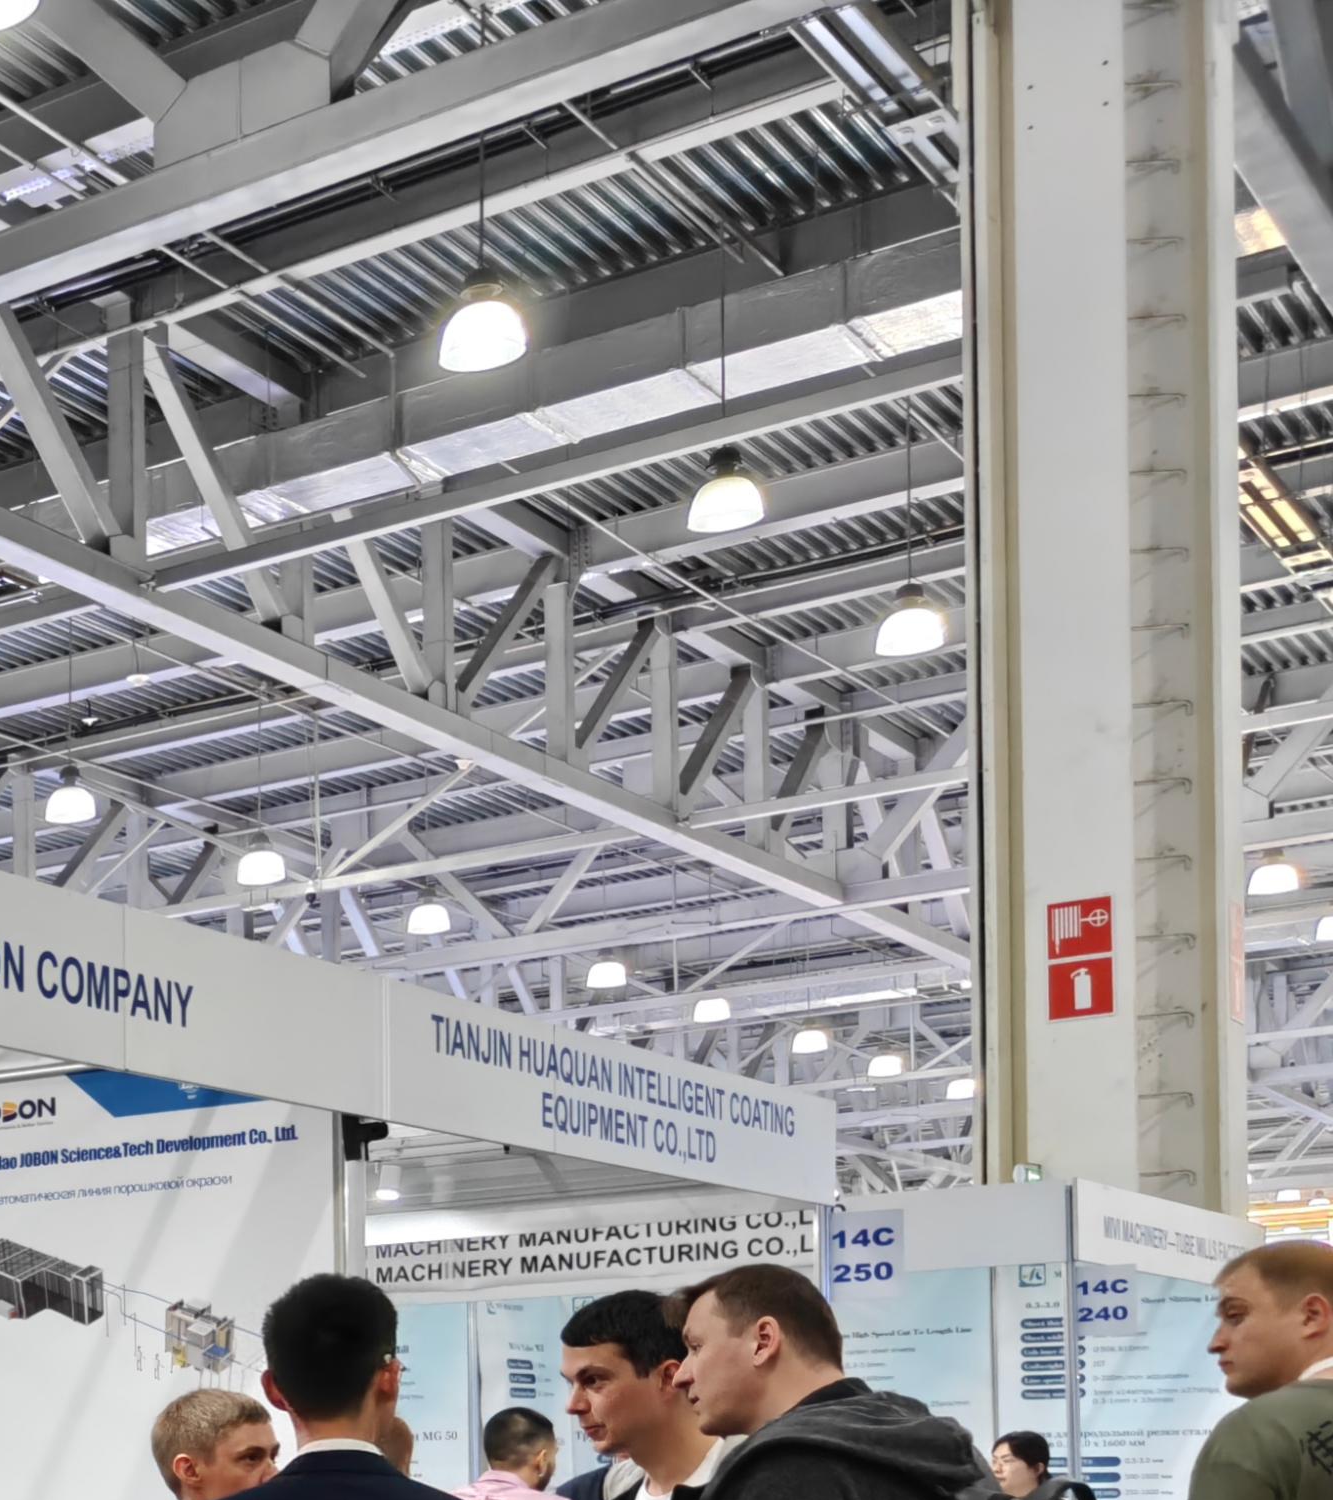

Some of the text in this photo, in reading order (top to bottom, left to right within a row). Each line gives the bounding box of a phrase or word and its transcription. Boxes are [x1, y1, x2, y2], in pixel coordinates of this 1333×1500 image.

[36, 950, 194, 1028] COMPANY
[431, 1013, 796, 1138] TIANJIN HUAQUAN INTELLIGENT COATING
[541, 1091, 717, 1165] EQUIPMENT CO.,LTD
[19, 1148, 59, 1168] JOBON
[60, 1140, 155, 1164] Science&Tech
[155, 1131, 247, 1155] Development
[274, 1124, 299, 1142] Ltd.
[77, 1184, 113, 1199] линия
[113, 1174, 185, 1197] порошковой
[186, 1173, 234, 1189] окраски
[376, 1234, 510, 1260] MACHINERY
[519, 1215, 737, 1249] MANUFACTURING
[831, 1227, 895, 1250] 14C
[376, 1257, 513, 1284] MACHINERY
[520, 1239, 739, 1275] MANUFACTURING
[832, 1261, 894, 1283] 250
[1076, 1278, 1129, 1296] 14C
[1077, 1305, 1129, 1323] 240
[422, 1430, 458, 1442] MG 50
